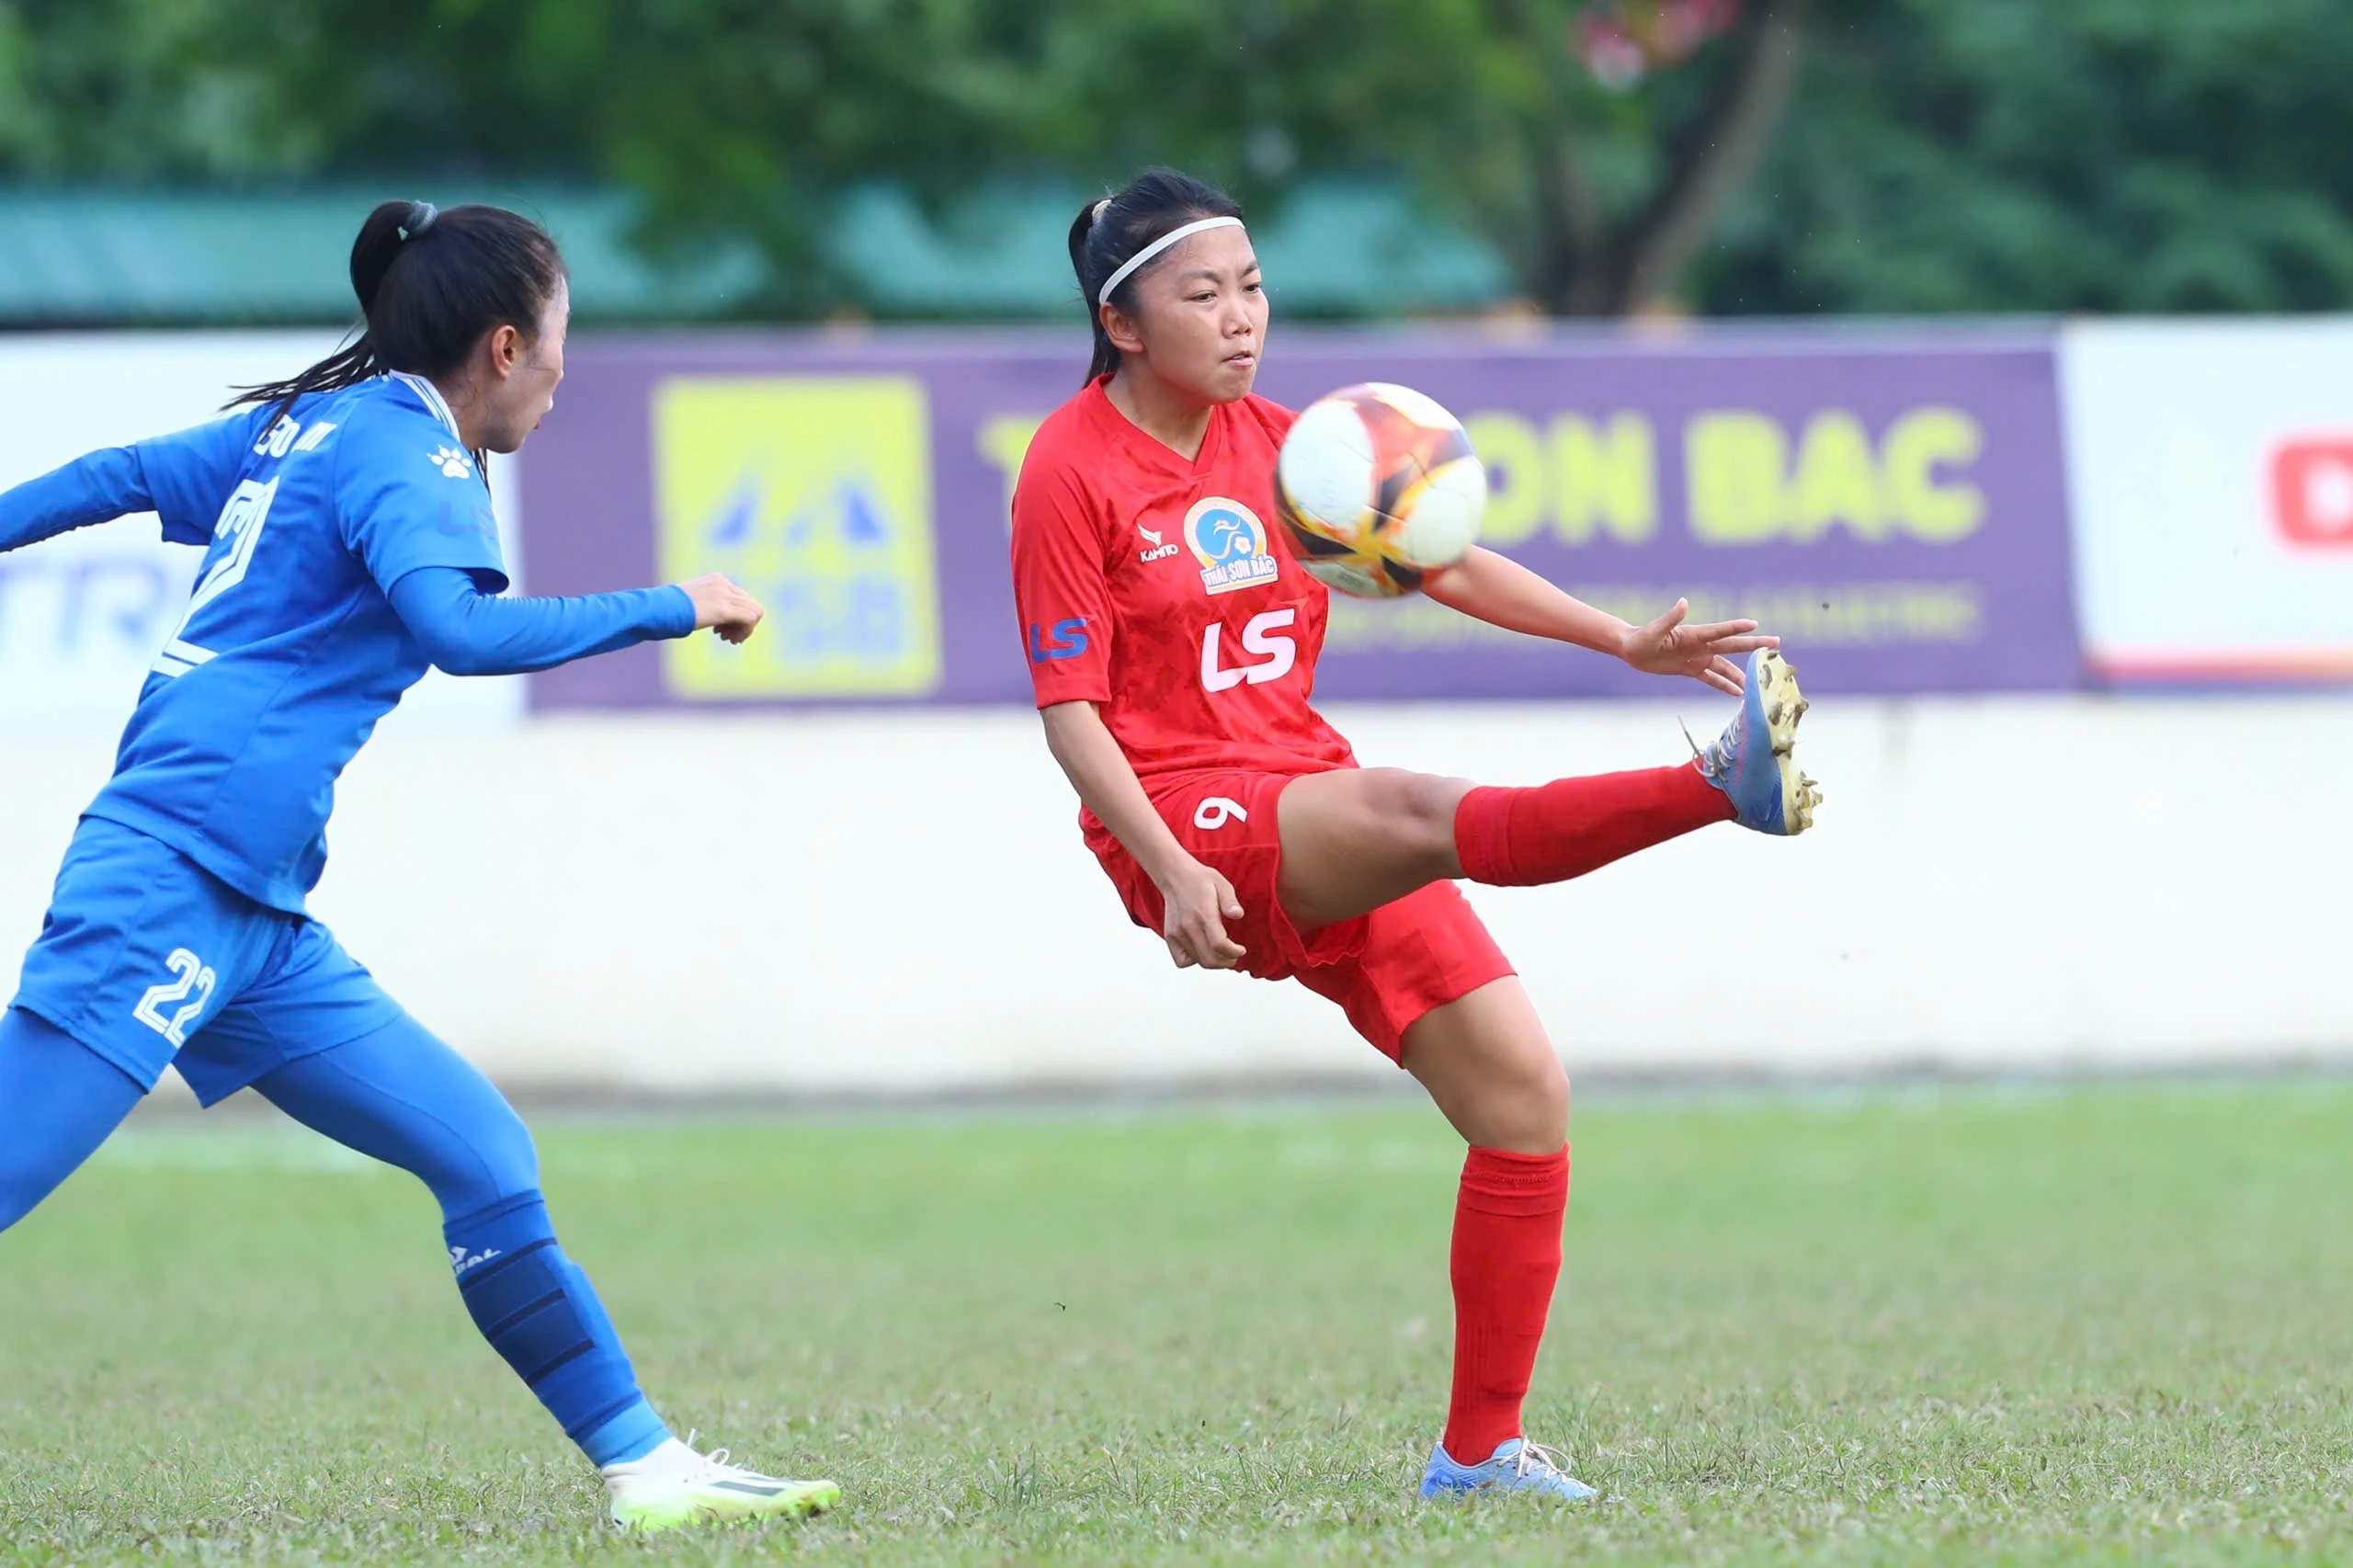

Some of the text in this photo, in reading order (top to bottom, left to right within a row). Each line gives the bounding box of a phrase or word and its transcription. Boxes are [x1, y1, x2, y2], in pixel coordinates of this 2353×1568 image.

[1463, 406, 1985, 545] ON BAC
[1140, 544, 1179, 562] KAMITO
[1030, 617, 1088, 664] LS
[1200, 608, 1296, 693] LS
[131, 947, 217, 1050] 22
